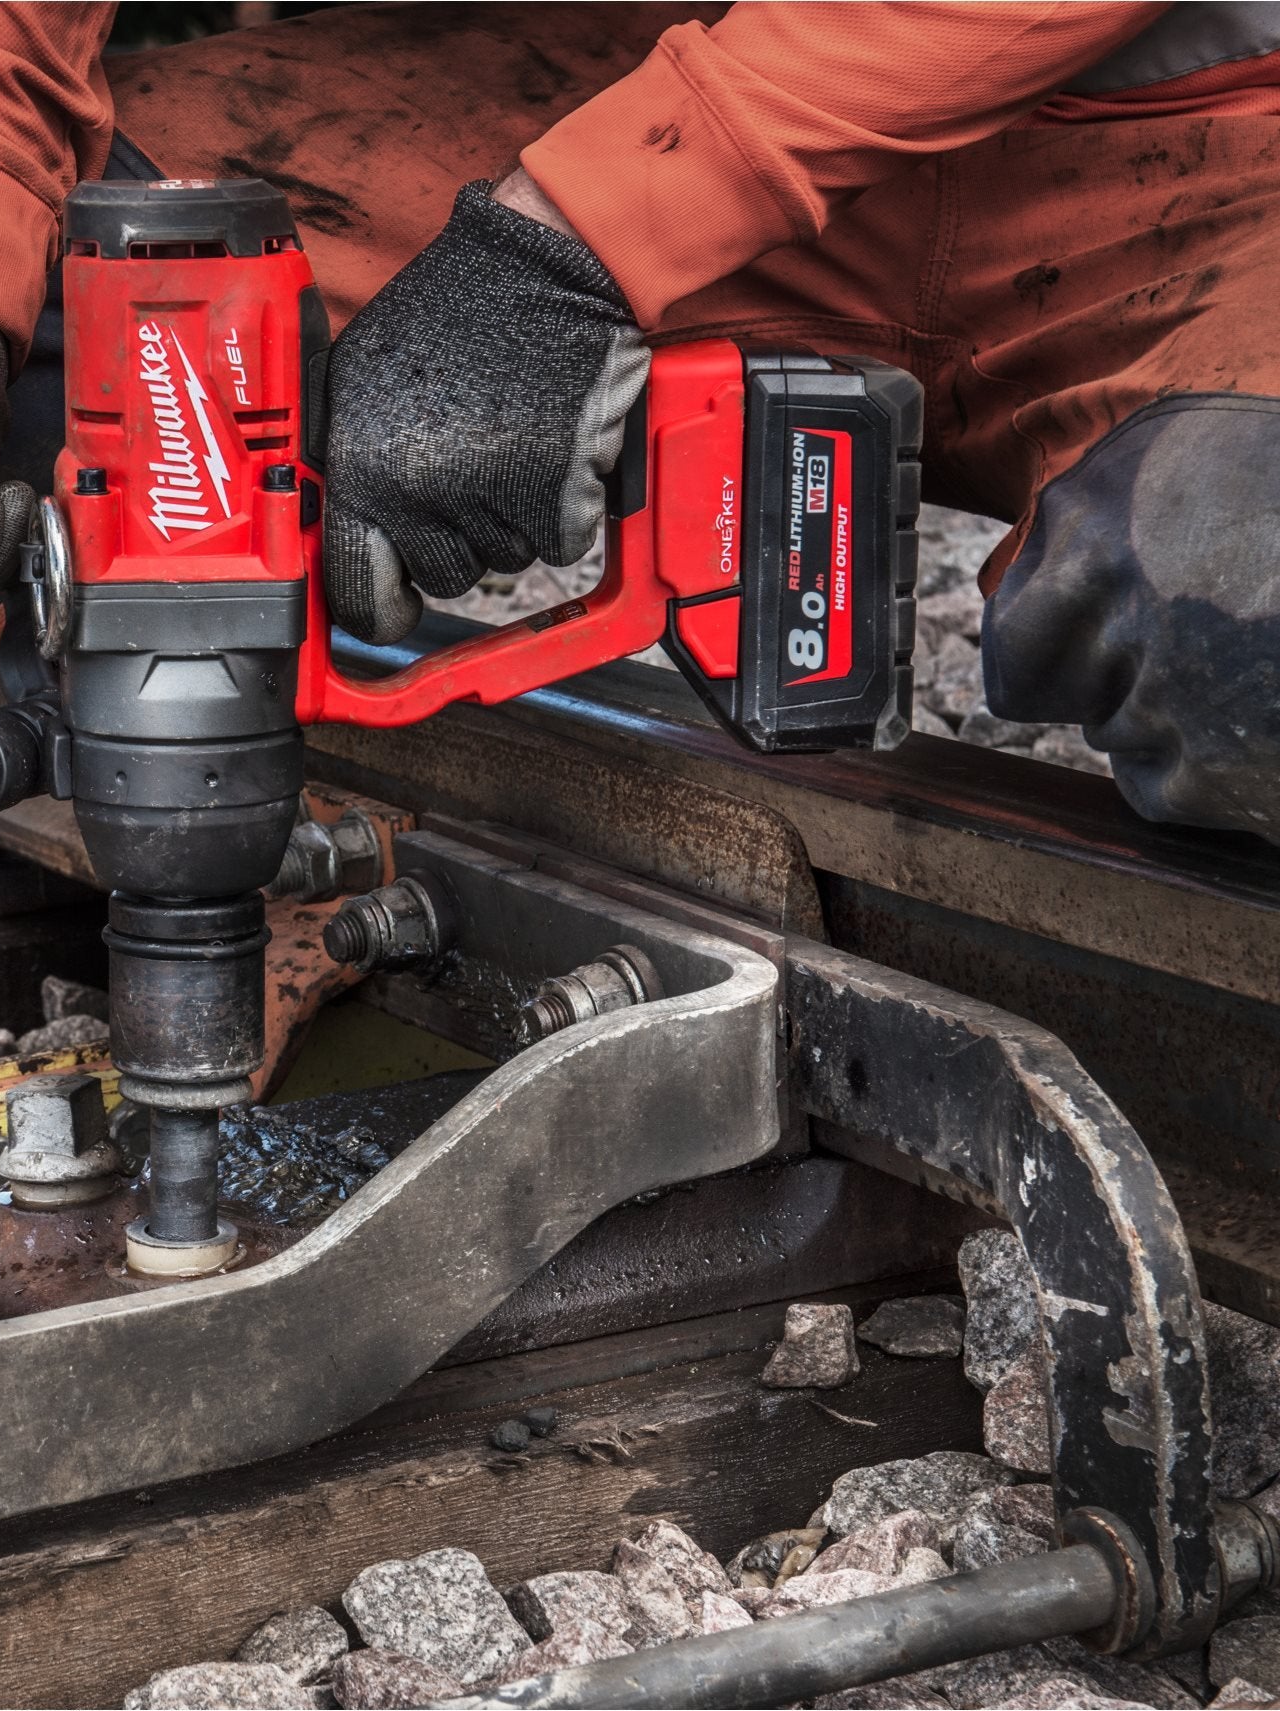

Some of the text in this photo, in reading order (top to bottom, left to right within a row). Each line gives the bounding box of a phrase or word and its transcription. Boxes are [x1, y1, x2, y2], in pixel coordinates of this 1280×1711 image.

[224, 328, 251, 405] FUEL
[138, 321, 214, 541] Milwaukee
[809, 458, 828, 511] M18
[834, 503, 849, 611] HIGH OUTPUT
[788, 573, 825, 670] 8.0 Ah
